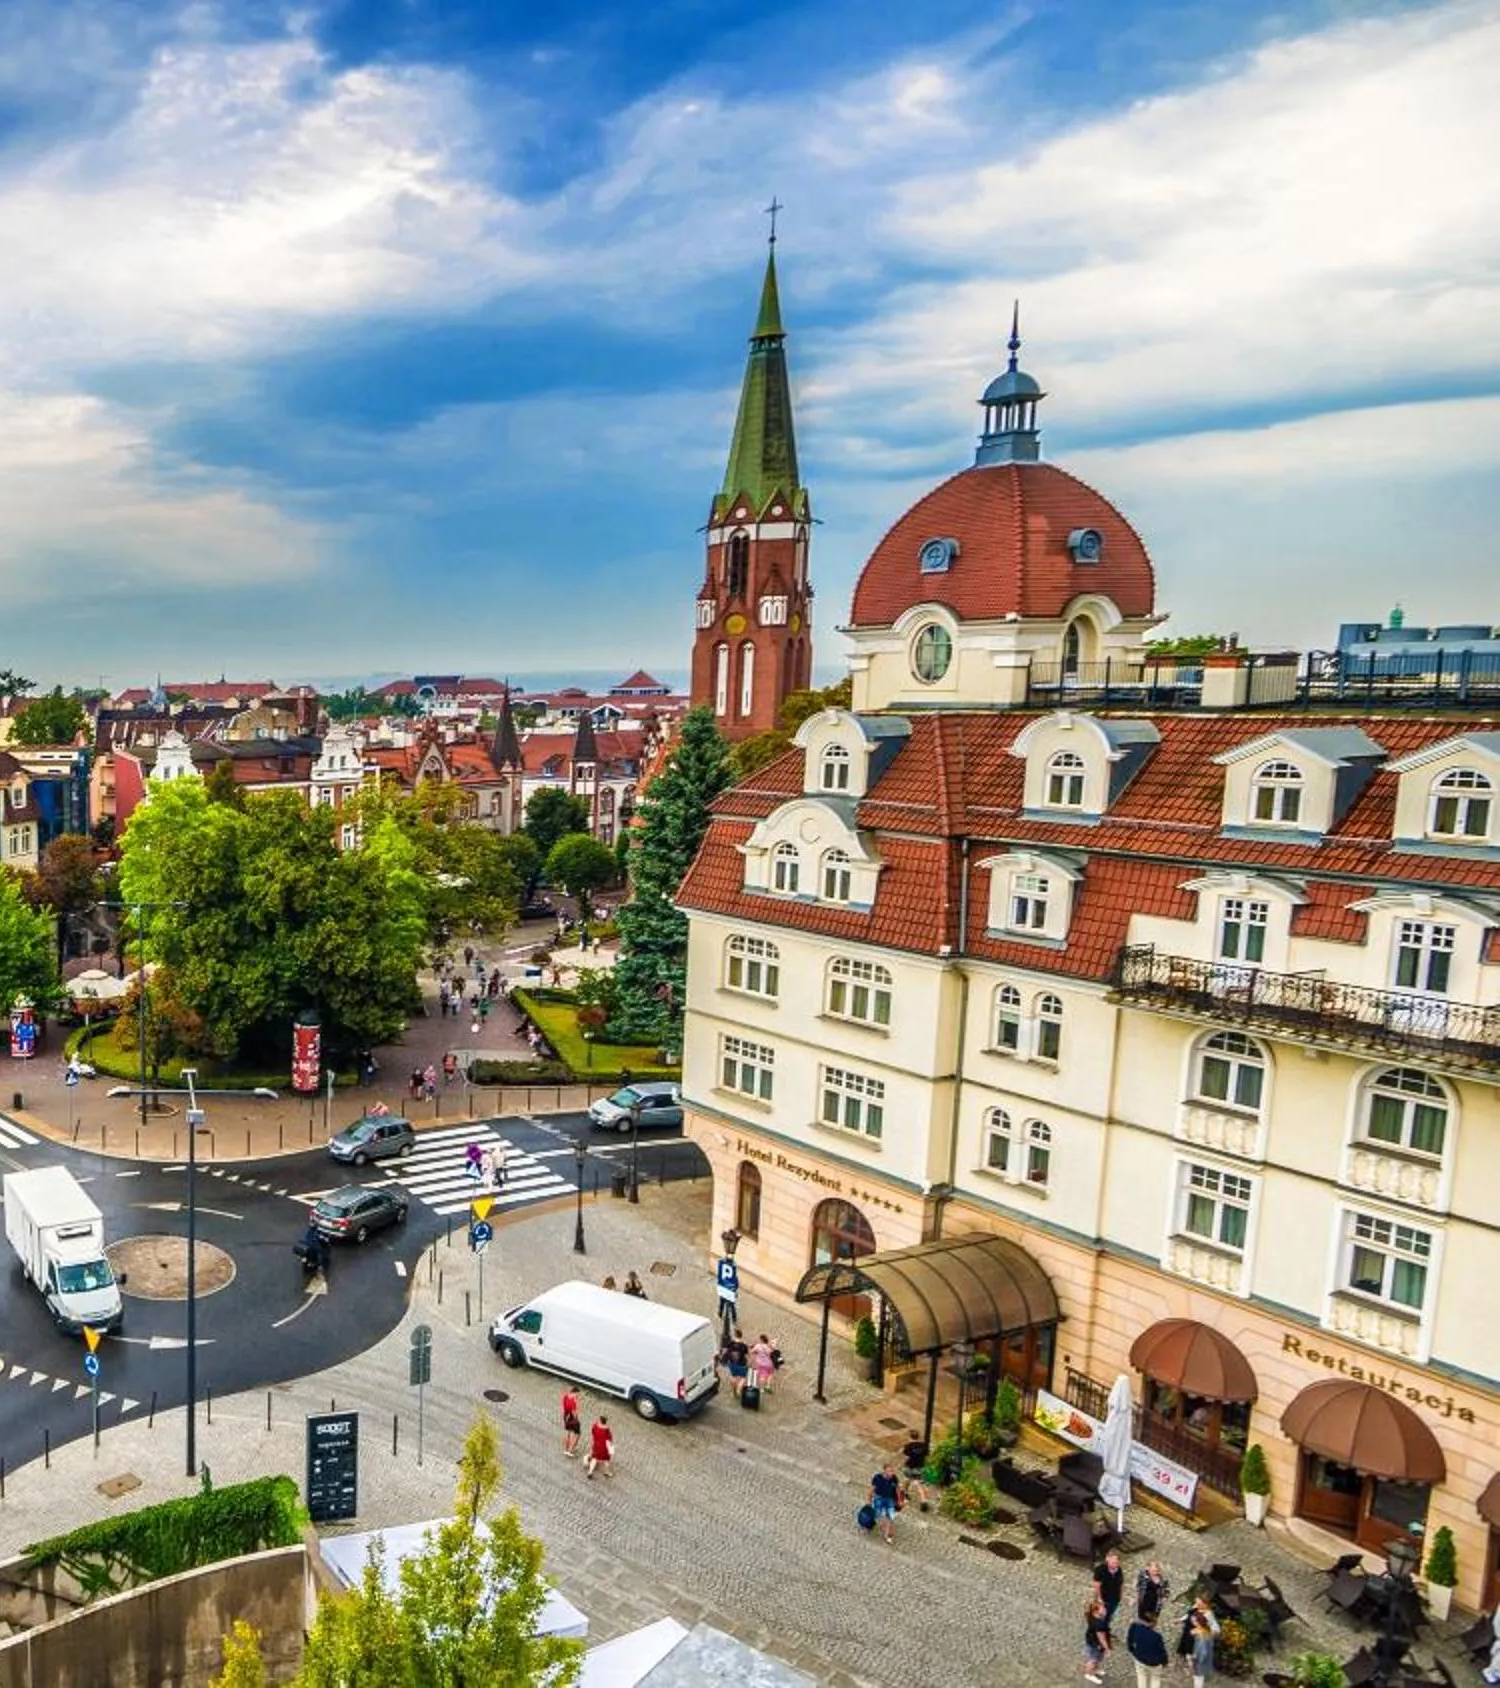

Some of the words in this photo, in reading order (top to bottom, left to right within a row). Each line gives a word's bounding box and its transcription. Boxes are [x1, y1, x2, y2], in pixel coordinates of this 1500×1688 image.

[737, 1139, 773, 1165] Hotel
[776, 1154, 842, 1193] Rezydent
[722, 1263, 733, 1280] P
[1282, 1333, 1477, 1424] Restauracja
